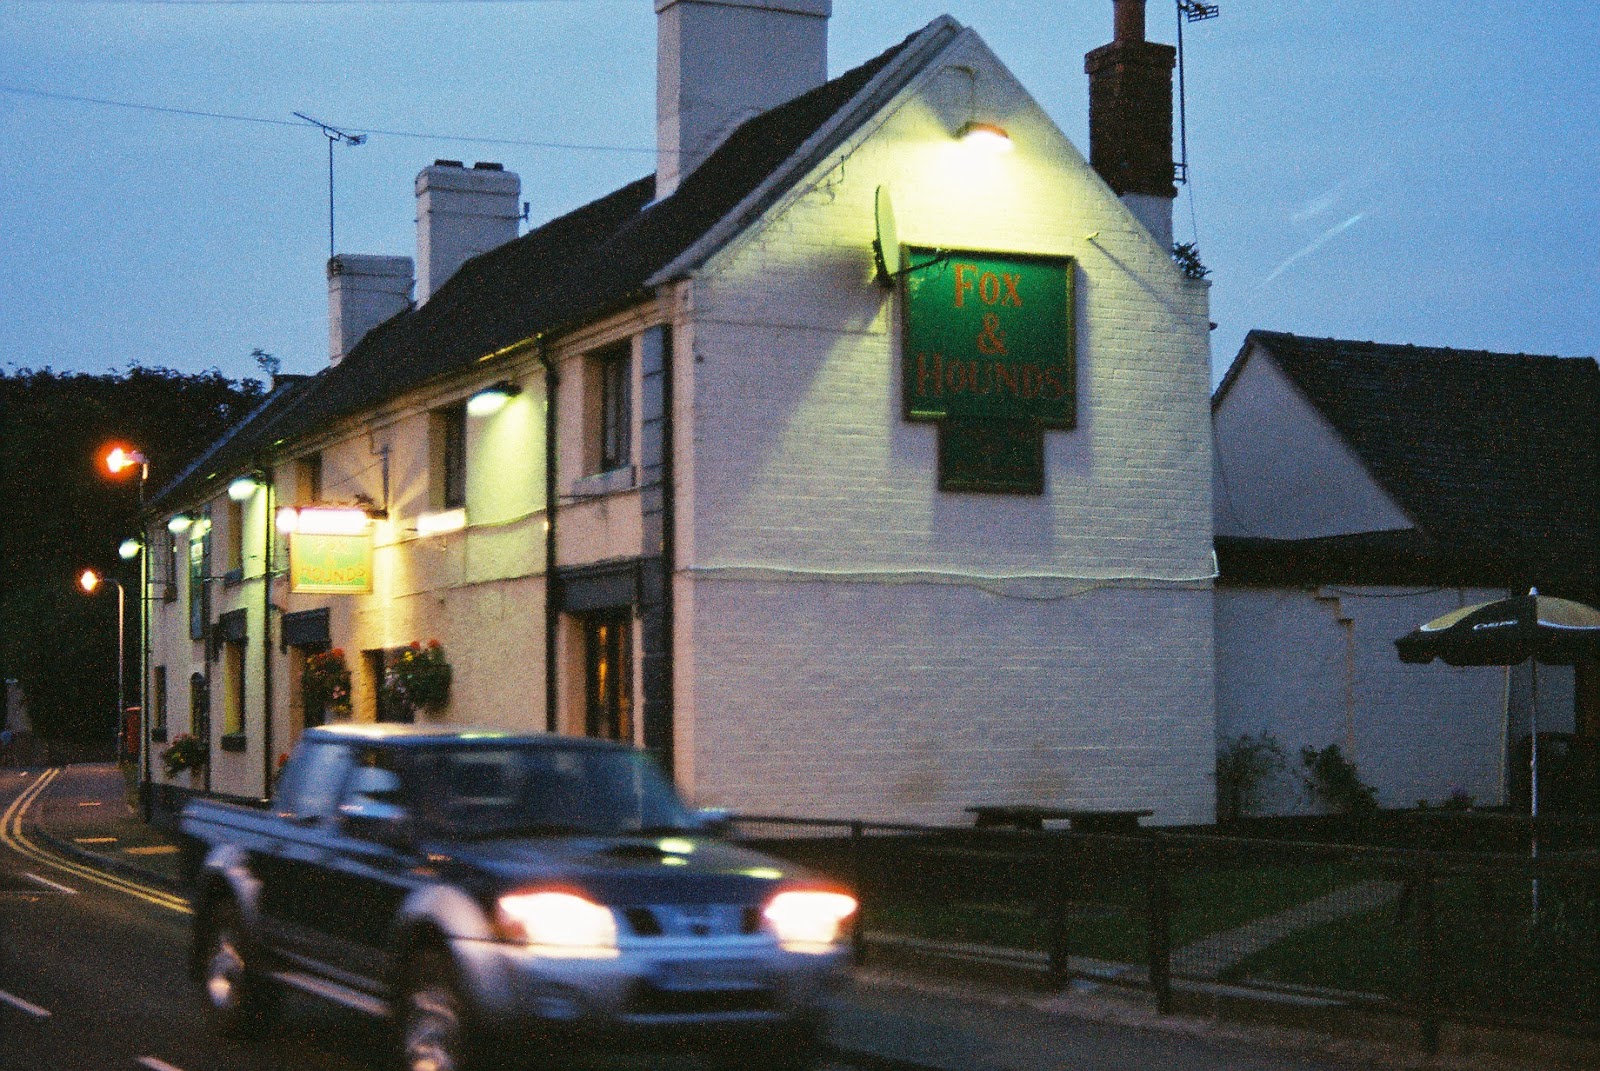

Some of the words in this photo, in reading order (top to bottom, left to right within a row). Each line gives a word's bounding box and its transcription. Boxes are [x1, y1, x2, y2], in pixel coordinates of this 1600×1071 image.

[954, 264, 1022, 307] FOX
[976, 311, 1008, 355] &
[916, 352, 1063, 399] HOUNDS
